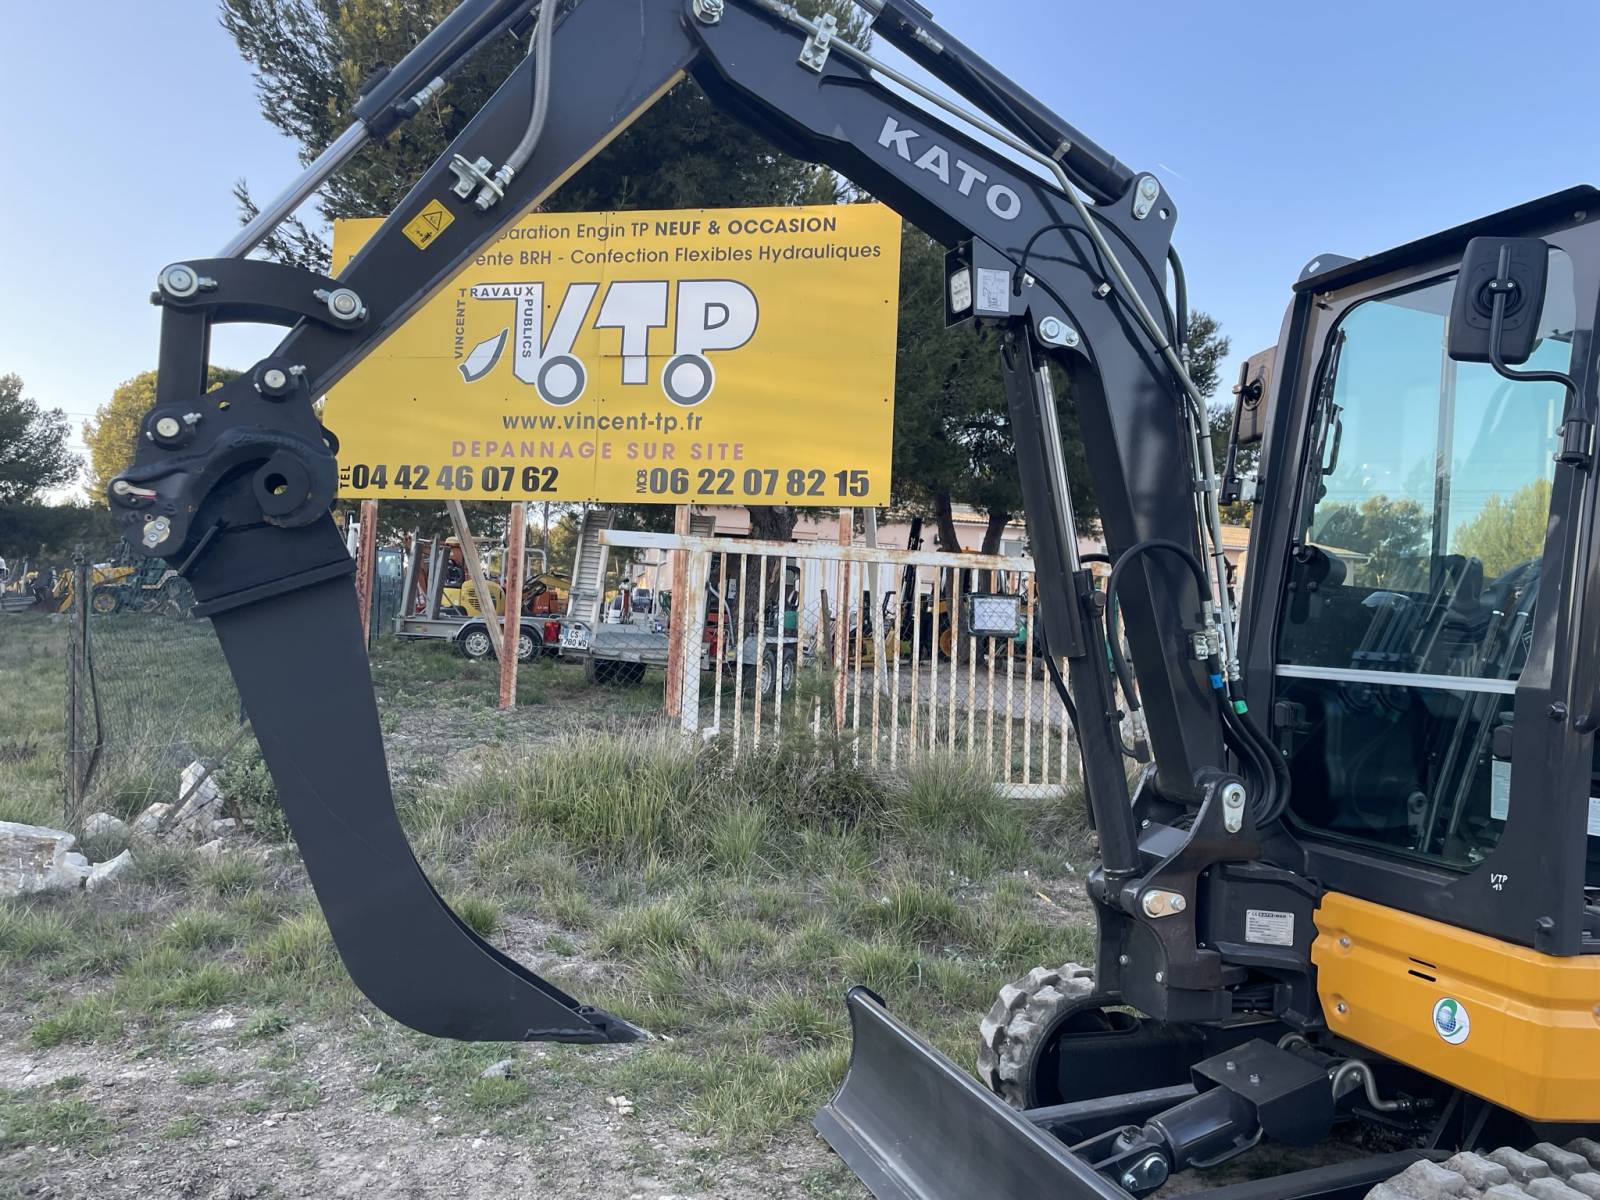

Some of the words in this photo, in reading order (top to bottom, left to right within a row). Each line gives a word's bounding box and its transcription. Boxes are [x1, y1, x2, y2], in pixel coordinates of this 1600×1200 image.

[878, 116, 1021, 220] KATO
[577, 223, 625, 241] Engin
[631, 222, 649, 237] TP
[655, 220, 701, 236] NEUF
[708, 220, 720, 235] &
[728, 217, 837, 234] OCCASION
[520, 250, 551, 265] BRH
[571, 248, 668, 264] Confection
[676, 246, 752, 262] Flexibles
[759, 244, 881, 263] Hydrauliques
[459, 286, 534, 297] TRAVAUX
[455, 300, 466, 359] VINCENT
[522, 299, 534, 358] PUBLICS
[503, 411, 703, 434] www.vincent-tp.fr
[452, 440, 612, 460] DEPANNAGE
[627, 442, 676, 460] SUR
[691, 443, 744, 461] SITE
[340, 465, 350, 489] TEL
[352, 464, 388, 489] 04
[394, 464, 430, 490] 42
[436, 465, 473, 491] 46
[481, 466, 515, 492] 07
[522, 466, 558, 492] 62
[636, 469, 648, 494] MOB
[650, 467, 689, 495] 06
[697, 468, 735, 495] 22
[743, 469, 779, 496] 07
[786, 469, 826, 496] 82
[834, 469, 869, 496] 15
[1490, 872, 1508, 884] VTP
